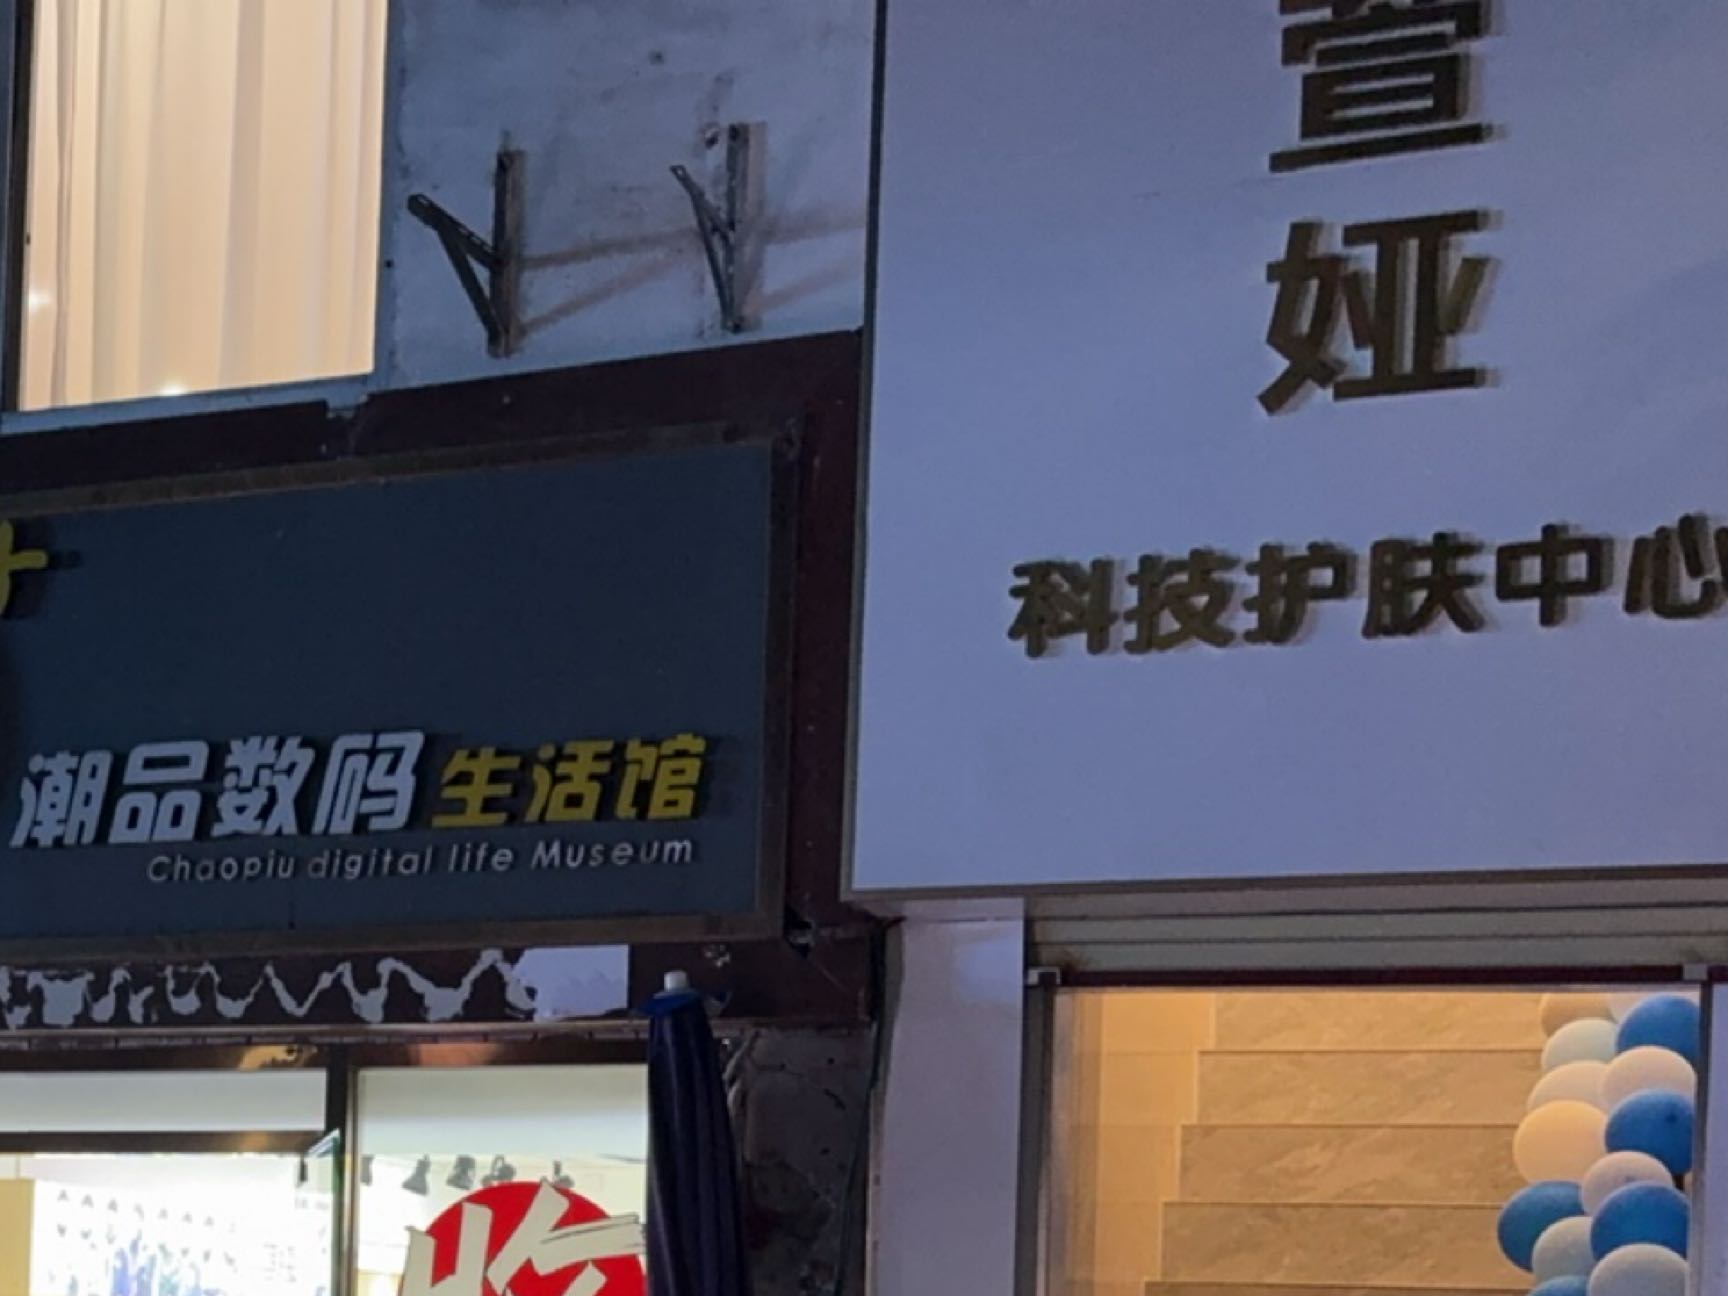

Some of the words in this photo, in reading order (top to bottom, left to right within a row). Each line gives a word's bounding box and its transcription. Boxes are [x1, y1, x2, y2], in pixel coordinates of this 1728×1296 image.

[1008, 515, 1728, 659] 科技护肤中心
[308, 845, 432, 880] digital
[447, 841, 514, 873] life
[531, 838, 693, 870] Museum
